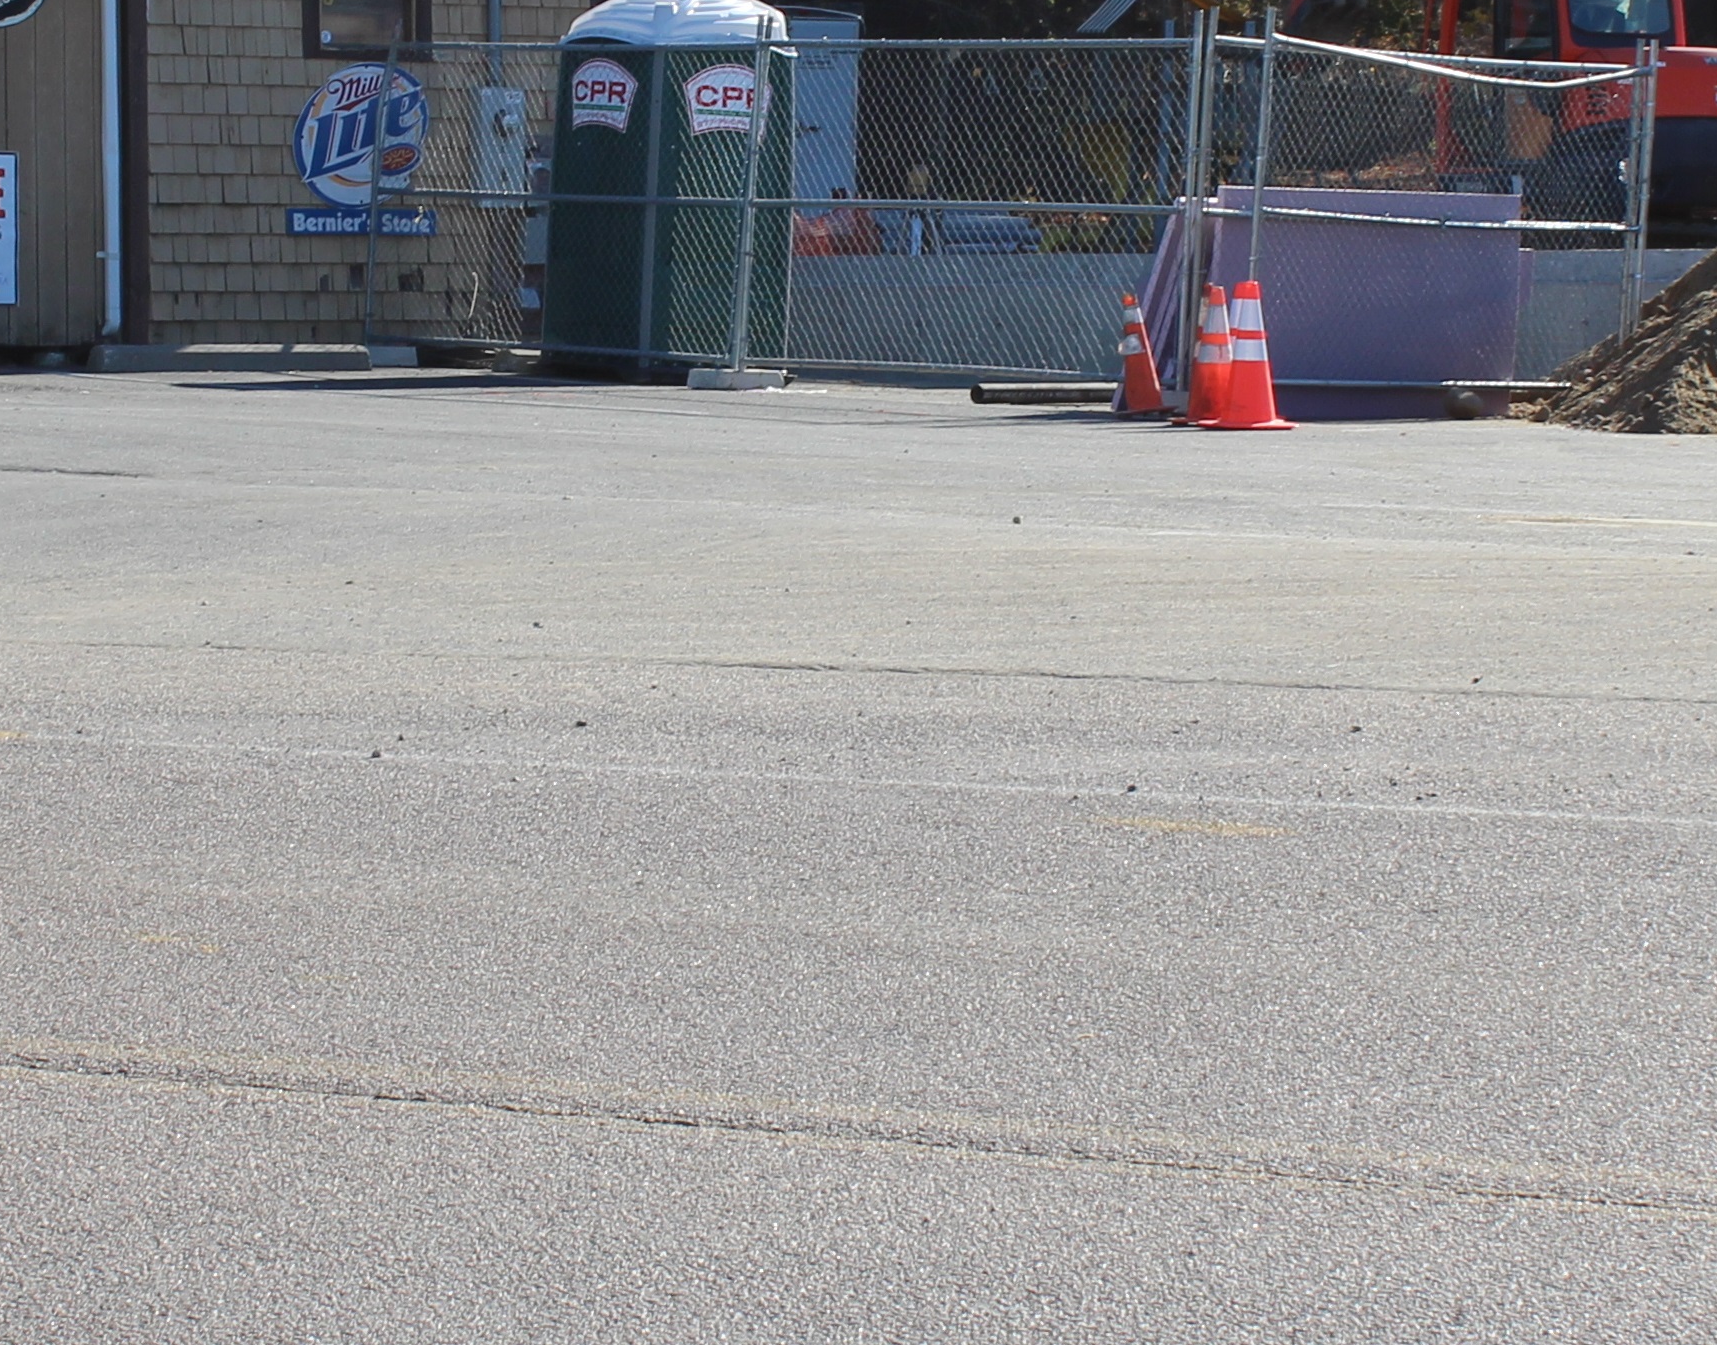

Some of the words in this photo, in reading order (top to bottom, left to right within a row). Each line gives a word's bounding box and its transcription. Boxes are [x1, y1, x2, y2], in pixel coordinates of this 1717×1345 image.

[574, 79, 627, 104] CPR
[302, 87, 424, 183] Lite
[292, 211, 371, 233] Bernier'
[381, 214, 431, 233] Store
